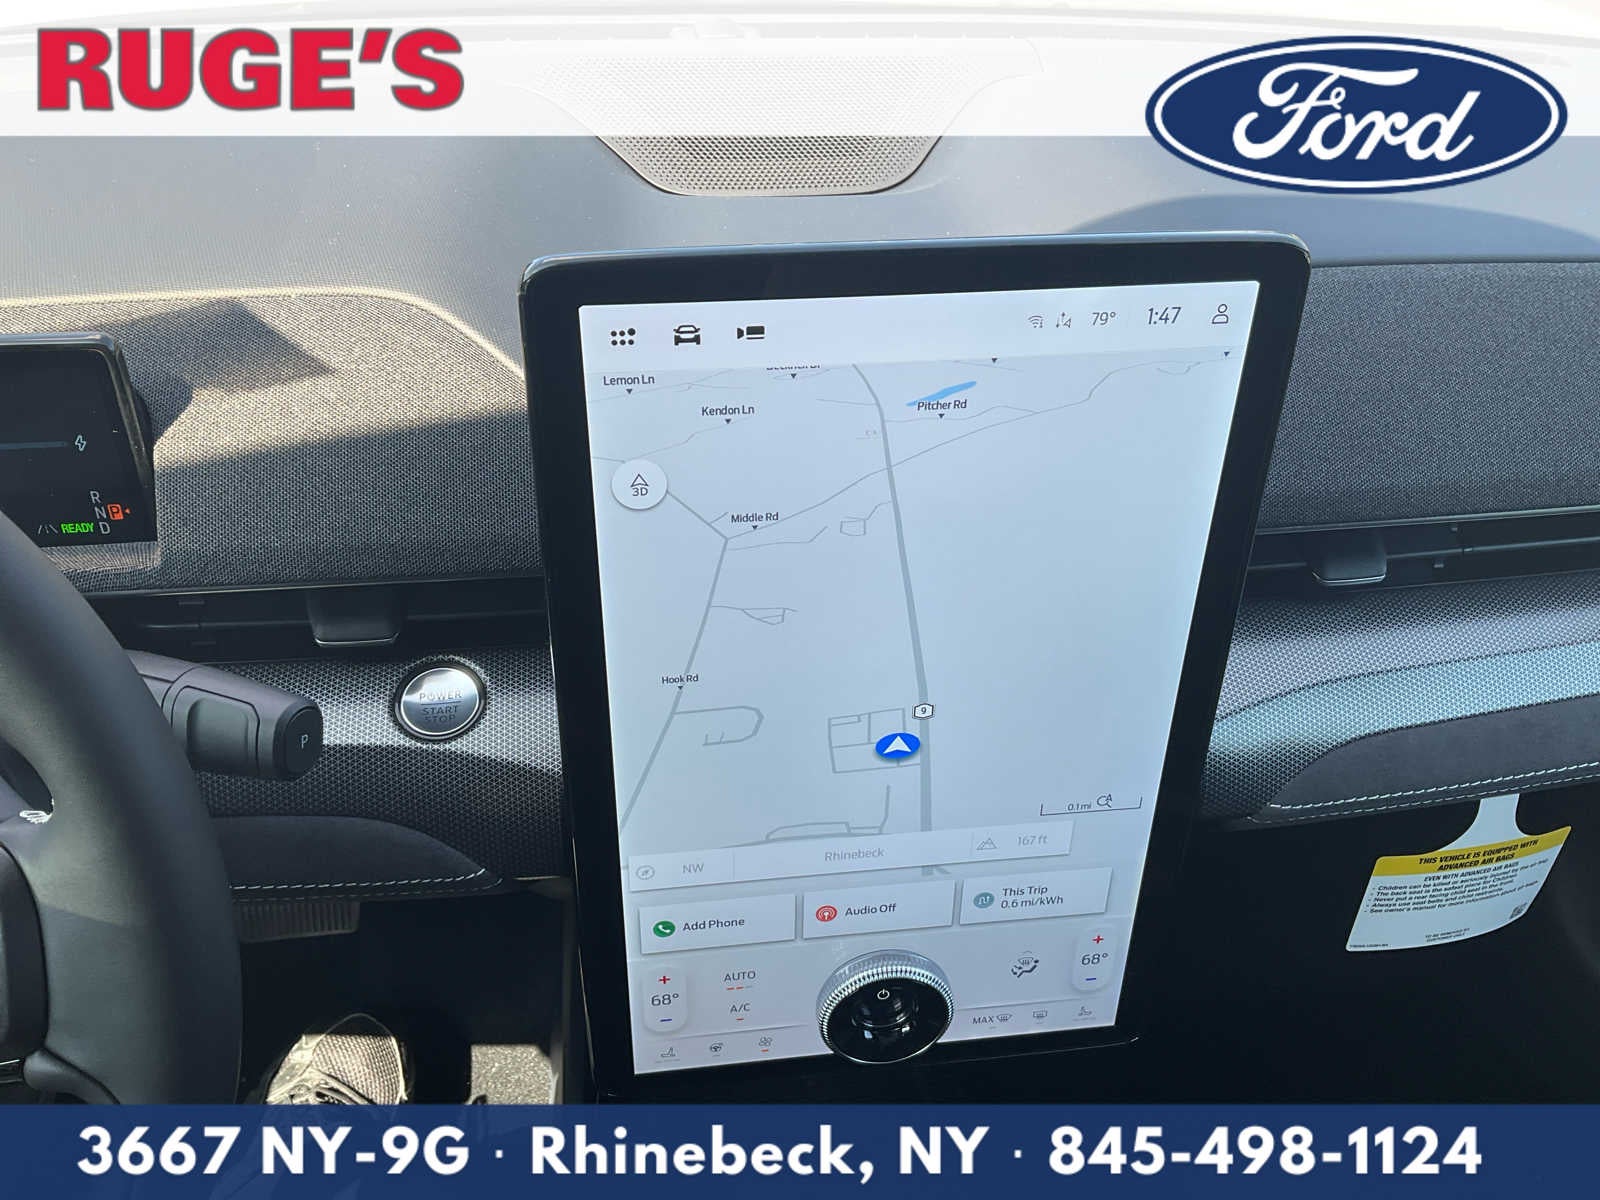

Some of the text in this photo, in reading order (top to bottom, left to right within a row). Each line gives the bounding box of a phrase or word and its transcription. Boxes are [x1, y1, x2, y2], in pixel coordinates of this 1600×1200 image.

[1091, 311, 1117, 326] 79°
[1147, 306, 1181, 325] 1:47
[602, 374, 655, 386] Lemon Ln
[701, 405, 755, 417] Kendon Ln
[917, 399, 967, 411] Pitcher Rd
[90, 491, 102, 504] R
[632, 486, 649, 497] 3D
[94, 505, 120, 519] N P
[731, 512, 779, 524] Middle Rd
[60, 521, 110, 534] READY D
[661, 674, 699, 685] Hook Rd
[419, 690, 463, 701] POWER
[422, 705, 459, 716] START
[920, 707, 927, 715] 9
[424, 714, 456, 724] STOP
[301, 734, 308, 749] P
[1017, 834, 1048, 847] 167 ft
[824, 847, 885, 862] Rhinebeck
[1419, 840, 1539, 865] THIS VEHICLE IS EQUIPPED WITH
[682, 863, 705, 874] NW
[1437, 861, 1479, 872] ADVANCED
[1496, 853, 1515, 862] BAGS
[1460, 867, 1492, 878] ADVANCED
[1504, 861, 1520, 869] BAGS
[1001, 886, 1048, 897] This Trip
[1001, 896, 1064, 909] 0.6 mi/kWh
[845, 902, 897, 917] Audio Off
[682, 917, 745, 932] Add Phone
[1081, 952, 1109, 966] 68°
[724, 970, 756, 982] AUTO
[651, 993, 680, 1007] 68°
[730, 1003, 751, 1013] A/C
[972, 1015, 994, 1025] MAX
